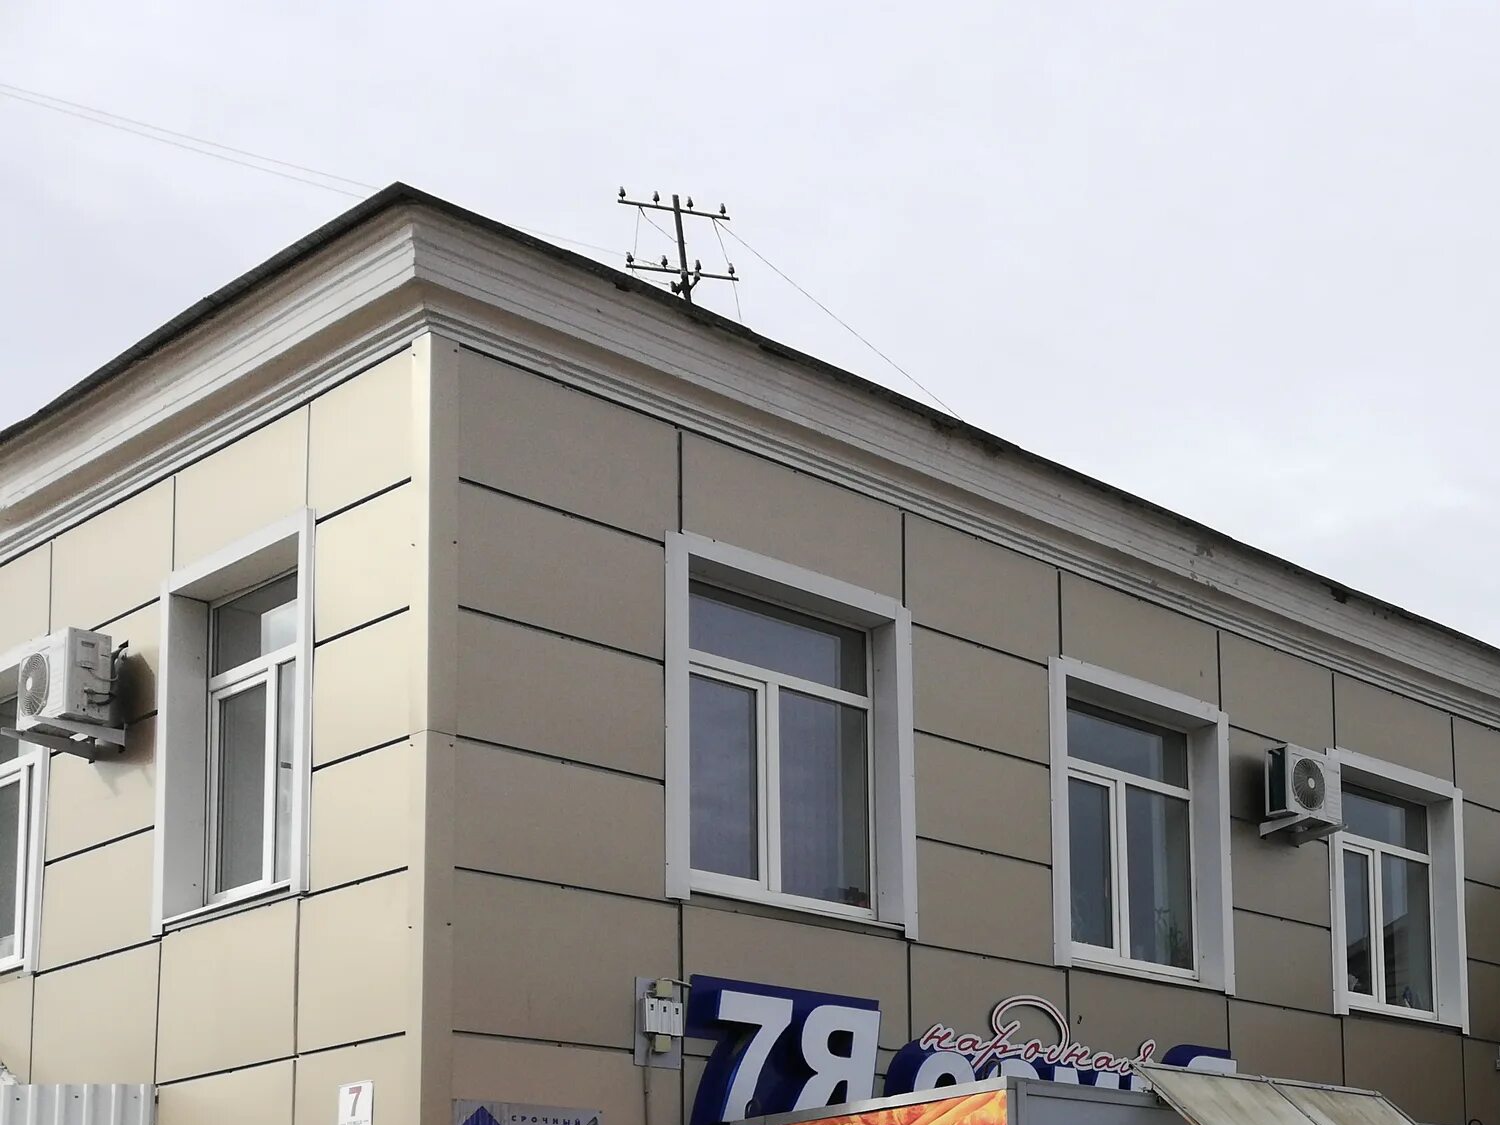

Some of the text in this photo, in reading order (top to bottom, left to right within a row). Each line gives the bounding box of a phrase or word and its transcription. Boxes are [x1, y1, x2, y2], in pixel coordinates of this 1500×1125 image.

[716, 989, 881, 1124] 7Я
[348, 1085, 362, 1117] 7
[511, 1114, 581, 1125] СРОЧНЫЙ
